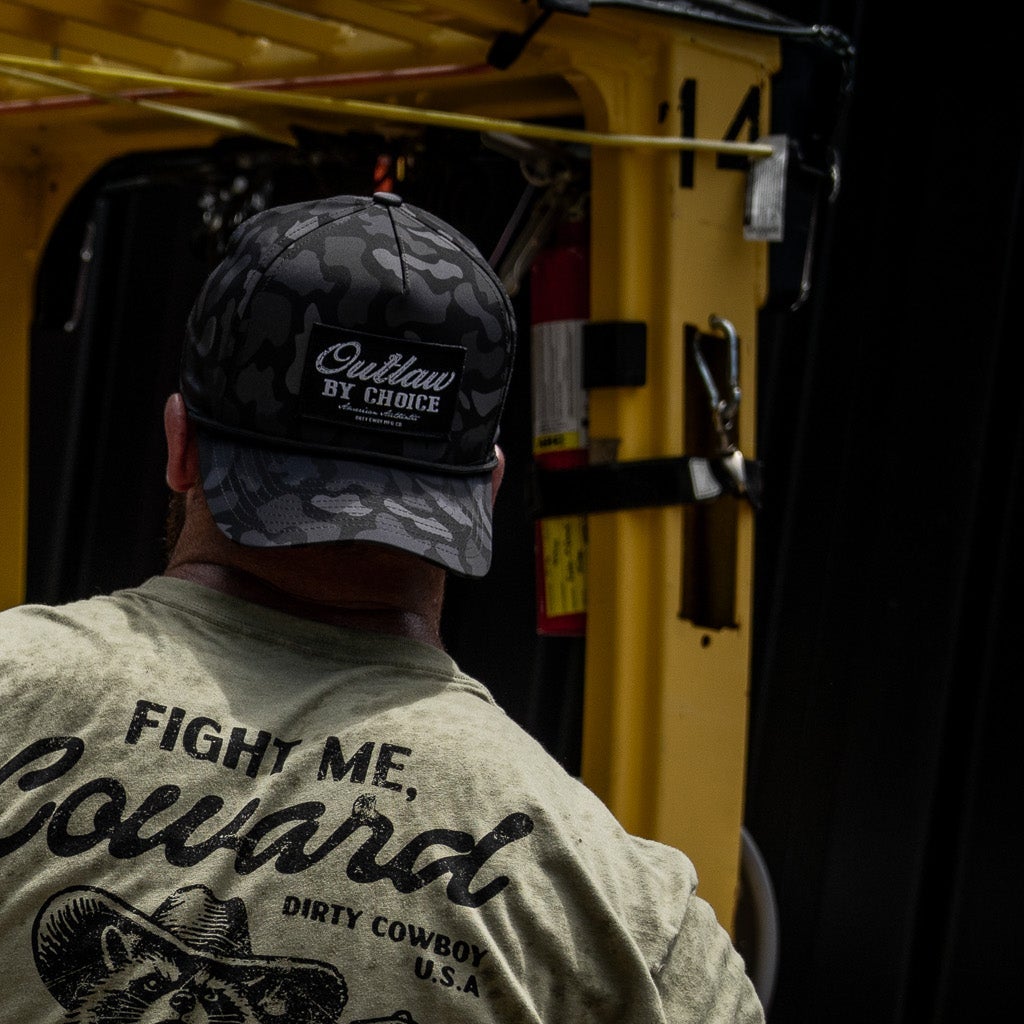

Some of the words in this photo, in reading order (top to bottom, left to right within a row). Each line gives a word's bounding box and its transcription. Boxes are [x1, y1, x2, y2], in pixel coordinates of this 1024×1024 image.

[680, 78, 760, 188] 14
[315, 341, 456, 391] Outlaw
[322, 378, 356, 400] BY
[364, 386, 441, 413] CHOICE
[125, 699, 303, 779] FIGHT
[317, 736, 417, 802] ME,
[282, 895, 363, 930] DIRTY
[372, 916, 488, 968] COWBOY
[415, 957, 480, 998] U.S.A
